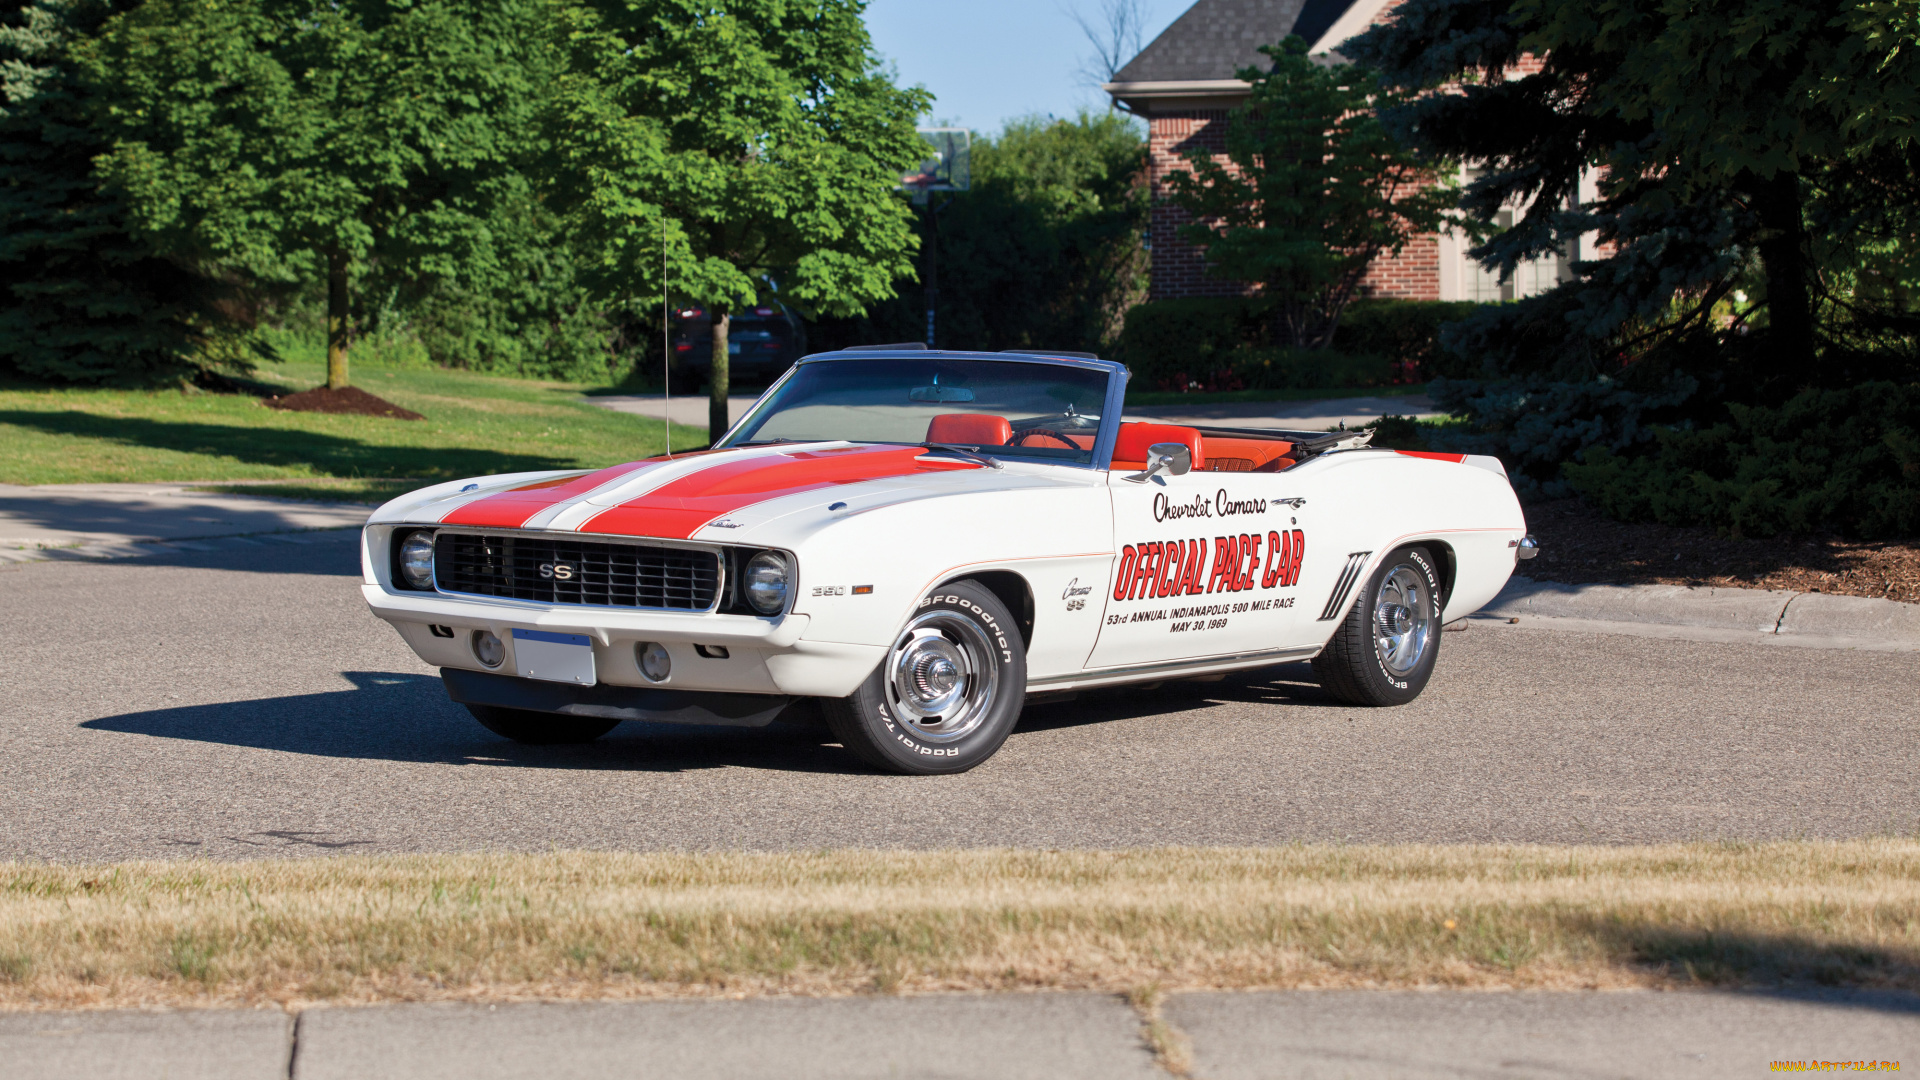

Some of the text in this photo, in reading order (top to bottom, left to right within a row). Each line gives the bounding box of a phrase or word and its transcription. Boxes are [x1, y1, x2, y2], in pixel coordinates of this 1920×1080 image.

[1153, 489, 1266, 522] Chevrolet Camaro
[539, 563, 573, 579] SS
[1113, 529, 1305, 601] OFFICIAL PACE CAR
[812, 585, 846, 596] 350
[1410, 551, 1440, 618] Radial T/A
[1107, 597, 1295, 625] 53rd ANNUAL INDIANAPOLIS 500 MILE RACE
[1169, 618, 1228, 633] MAY 30, 1969
[919, 595, 1012, 663] BFGoodrich
[878, 703, 959, 756] Radial T/A
